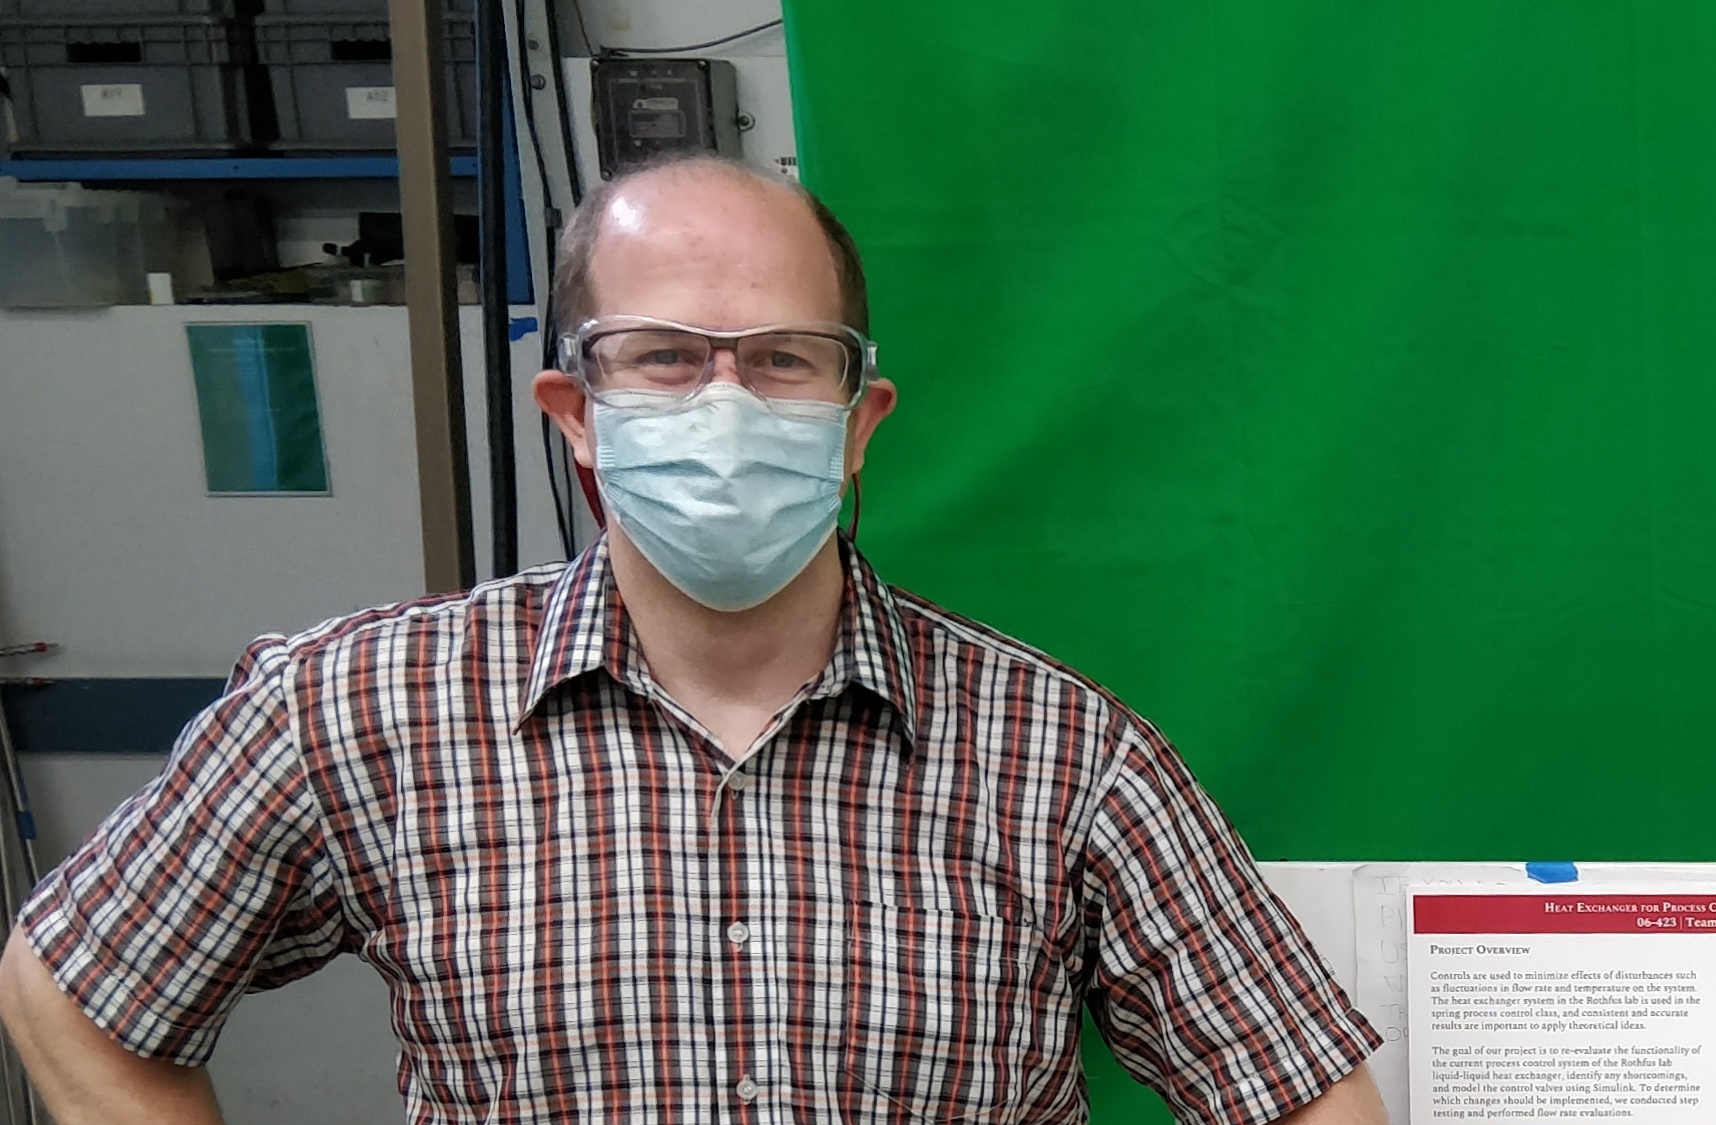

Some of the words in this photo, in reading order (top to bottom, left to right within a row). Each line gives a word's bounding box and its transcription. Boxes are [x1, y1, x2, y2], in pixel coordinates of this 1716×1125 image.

[1637, 917, 1676, 927] 06-423
[1431, 971, 1470, 980] Controls
[1490, 970, 1511, 980] used
[1525, 971, 1568, 980] minimize
[1571, 970, 1601, 980] effects
[1604, 970, 1613, 980] of
[1615, 970, 1673, 980] disturbances
[1676, 970, 1696, 979] such
[1443, 983, 1497, 993] fluctuations
[1500, 982, 1509, 992] in
[1512, 983, 1532, 993] flow
[1555, 983, 1572, 992] and
[1574, 985, 1630, 996] temperature
[1647, 983, 1661, 992] the
[1664, 985, 1697, 996] system.
[1433, 995, 1449, 1005] The
[1452, 995, 1471, 1005] heat
[1473, 995, 1520, 1008] exchanger
[1523, 997, 1554, 1007] system
[1557, 995, 1566, 1005] in
[1569, 995, 1583, 1005] the
[1586, 995, 1622, 1005] Rothfus
[1624, 995, 1639, 1005] lab
[1641, 996, 1648, 1005] is
[1651, 995, 1672, 1005] used
[1674, 995, 1683, 1005] in
[1686, 995, 1700, 1005] the
[1432, 1010, 1460, 1020] spring
[1463, 1010, 1497, 1020] process
[1500, 1007, 1533, 1018] control
[1535, 1008, 1560, 1019] class,
[1562, 1007, 1579, 1018] and
[1582, 1009, 1628, 1018] consistent
[1631, 1008, 1648, 1018] and
[1650, 1010, 1688, 1018] accurate
[1432, 1046, 1450, 1055] The
[1452, 1045, 1472, 1057] goal
[1475, 1045, 1484, 1055] of
[1504, 1046, 1536, 1058] project
[1539, 1046, 1546, 1055] is
[1561, 1045, 1611, 1055] re-evaluate
[1614, 1045, 1628, 1055] the
[1631, 1045, 1689, 1057] functionality
[1692, 1045, 1701, 1055] of
[1433, 1058, 1447, 1068] the
[1449, 1060, 1483, 1068] current
[1486, 1060, 1520, 1070] process
[1522, 1057, 1555, 1067] control
[1558, 1060, 1589, 1070] system
[1592, 1057, 1601, 1067] of
[1603, 1058, 1618, 1068] the
[1621, 1057, 1656, 1067] Rothfus
[1659, 1058, 1672, 1067] lab
[1433, 1070, 1490, 1082] liquid-liquid
[1493, 1070, 1512, 1080] heat
[1515, 1070, 1564, 1082] exchanger,
[1567, 1070, 1602, 1082] identify
[1604, 1073, 1620, 1082] any
[1623, 1070, 1687, 1082] shortcomings,
[1433, 1083, 1449, 1093] and
[1452, 1082, 1480, 1093] model
[1483, 1083, 1497, 1093] the
[1500, 1082, 1533, 1093] control
[1535, 1083, 1563, 1093] valves
[1566, 1083, 1590, 1094] using
[1593, 1082, 1636, 1092] Simulink.
[1639, 1083, 1651, 1092] To
[1654, 1082, 1700, 1092] determine
[1433, 1095, 1461, 1105] which
[1464, 1095, 1500, 1107] changes
[1504, 1095, 1534, 1105] should
[1537, 1095, 1546, 1105] be
[1550, 1095, 1612, 1107] implemented,
[1630, 1095, 1677, 1105] conducted
[1680, 1097, 1698, 1107] step
